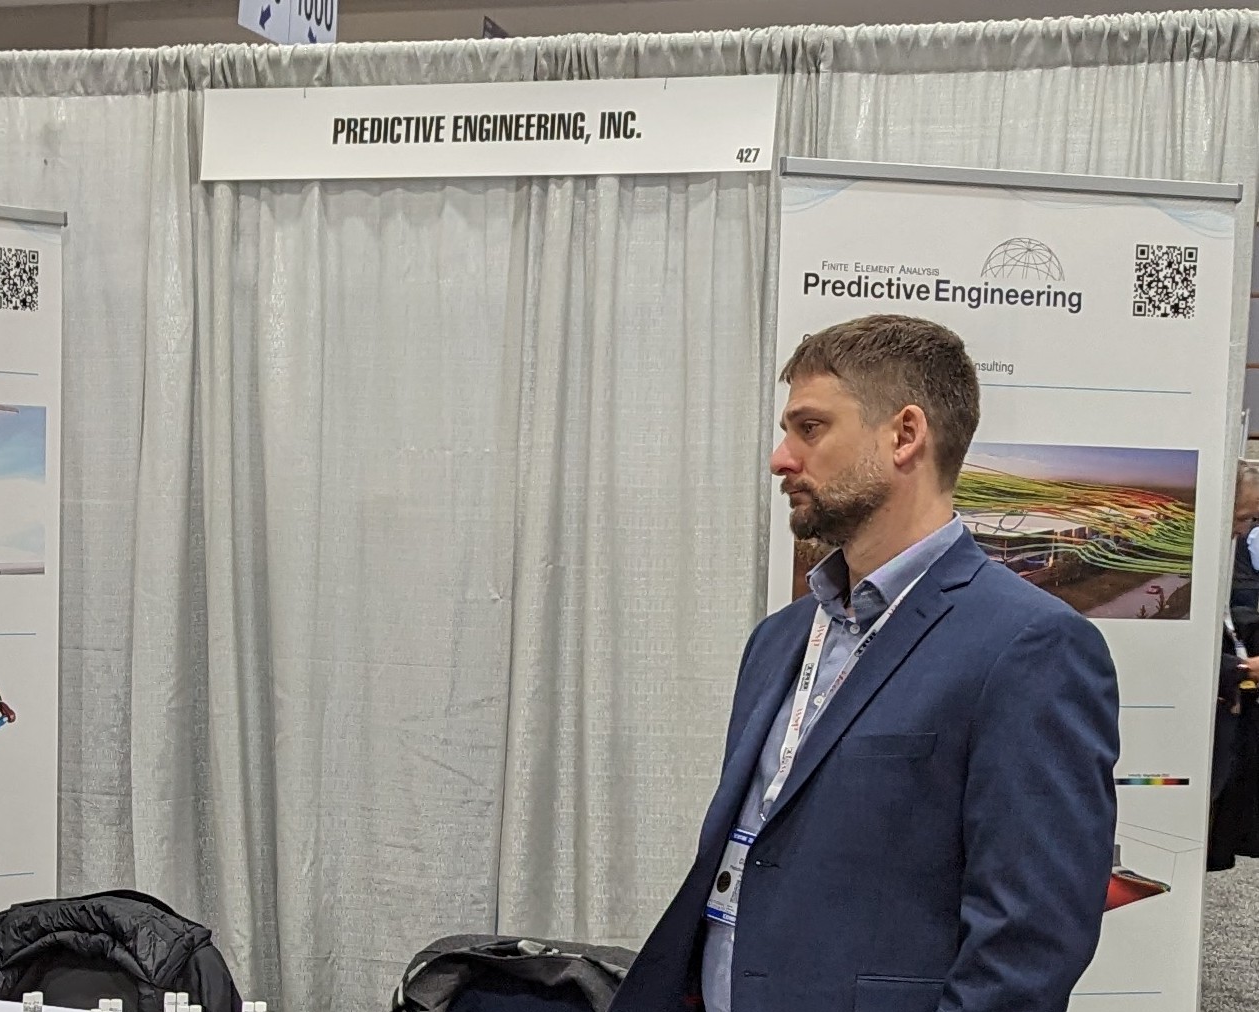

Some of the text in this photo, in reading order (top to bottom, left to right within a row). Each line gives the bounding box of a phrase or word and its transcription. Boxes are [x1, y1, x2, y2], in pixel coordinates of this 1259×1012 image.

[332, 110, 642, 145] PREDICTIVE ENGINEERING, INC.
[736, 147, 761, 163] 427
[821, 260, 940, 276] FINITE ELEMENT ANALYSIS
[803, 272, 1082, 314] Predictive Engineering
[974, 359, 1014, 376] nsulting
